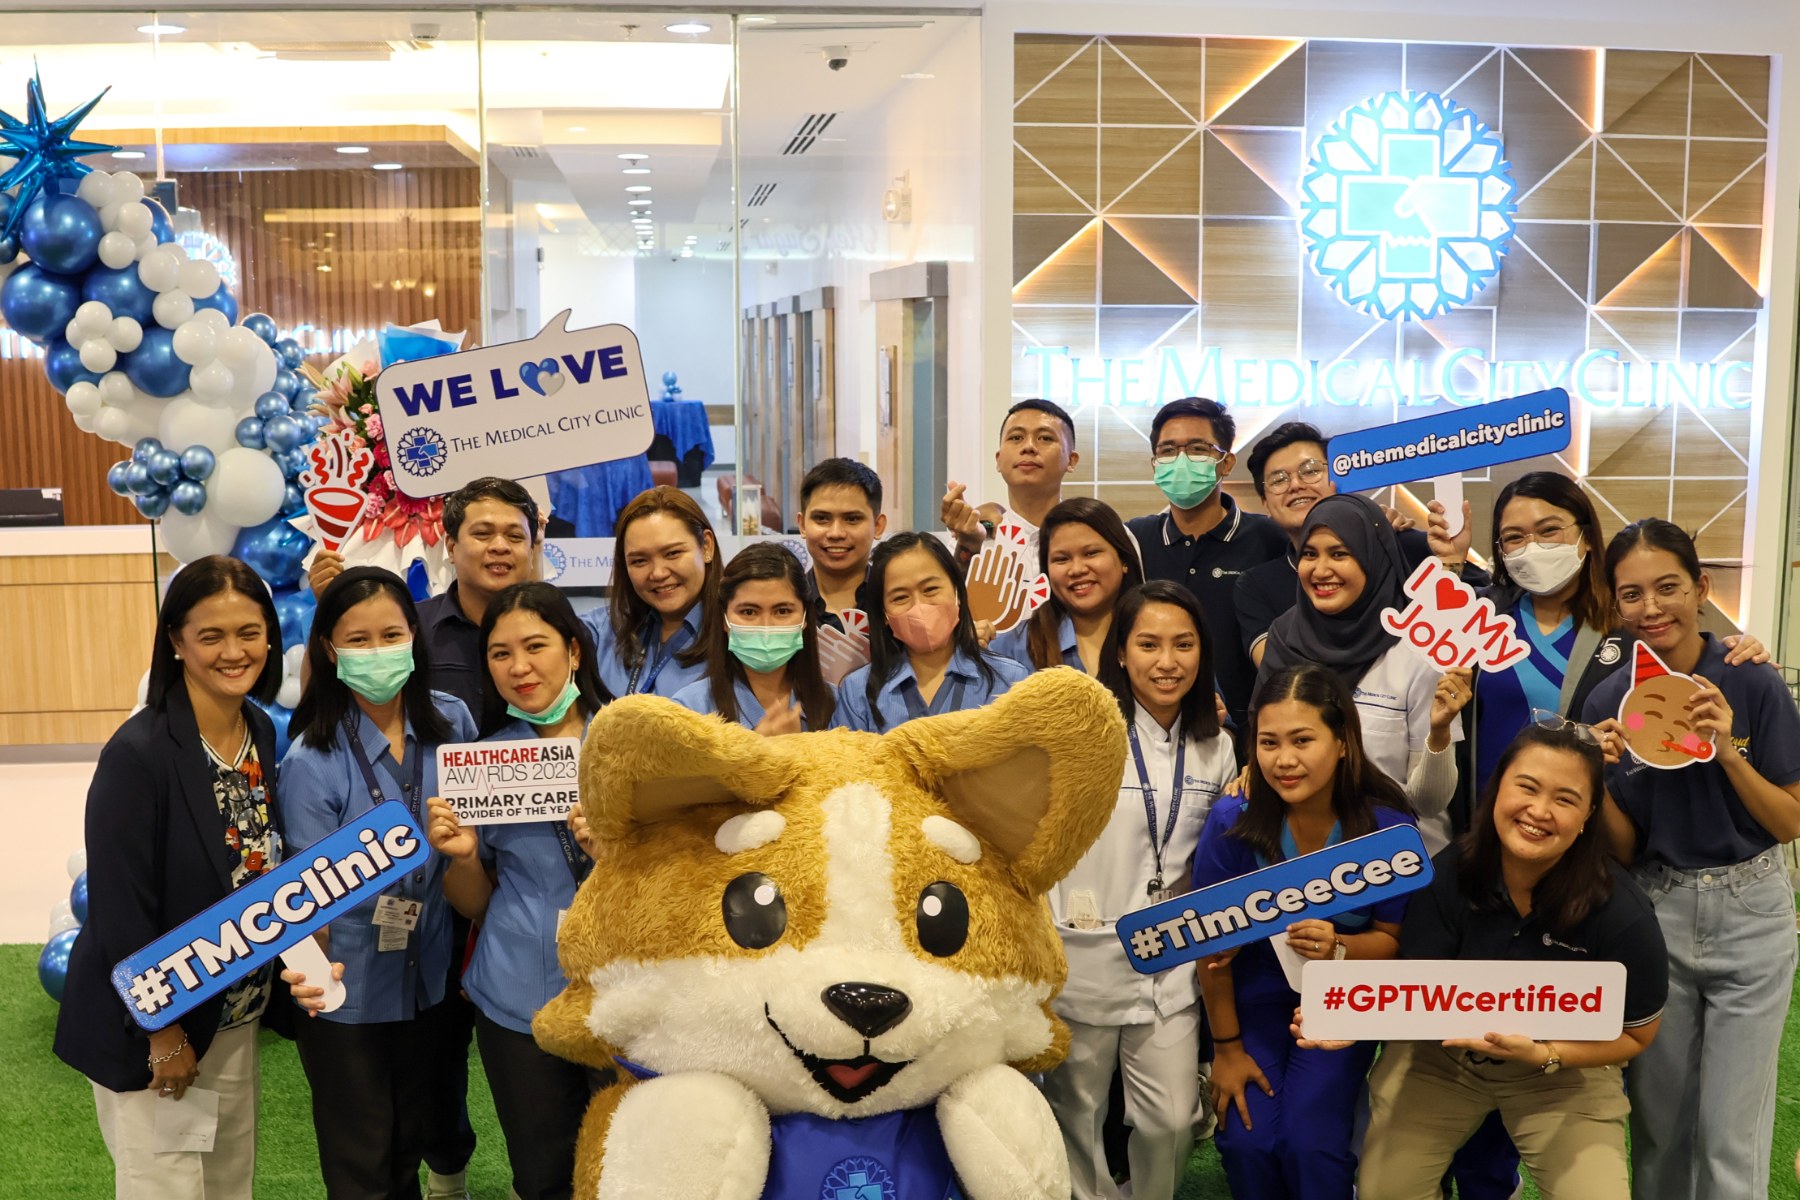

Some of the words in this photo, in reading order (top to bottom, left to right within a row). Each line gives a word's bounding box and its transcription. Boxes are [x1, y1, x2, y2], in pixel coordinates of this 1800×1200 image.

[393, 373, 477, 417] WE
[1023, 346, 1147, 407] THE
[1152, 346, 1438, 407] MEDICAL
[1575, 348, 1753, 408] CLINIC
[451, 437, 482, 453] THE
[485, 423, 556, 447] MEDICAL
[557, 414, 592, 432] CITY
[595, 405, 645, 425] CLINIC
[1332, 409, 1566, 477] @themedicalcityclinic
[570, 556, 592, 568] THE
[1410, 562, 1436, 592] I
[1462, 604, 1524, 666] My
[532, 761, 577, 780] 2023
[506, 807, 521, 817] OF
[525, 806, 547, 815] THE
[549, 805, 571, 814] YEA
[531, 790, 579, 805] CARE
[1129, 849, 1424, 960] #TimCeeCee
[1323, 984, 1603, 1013] #GPTWcertified
